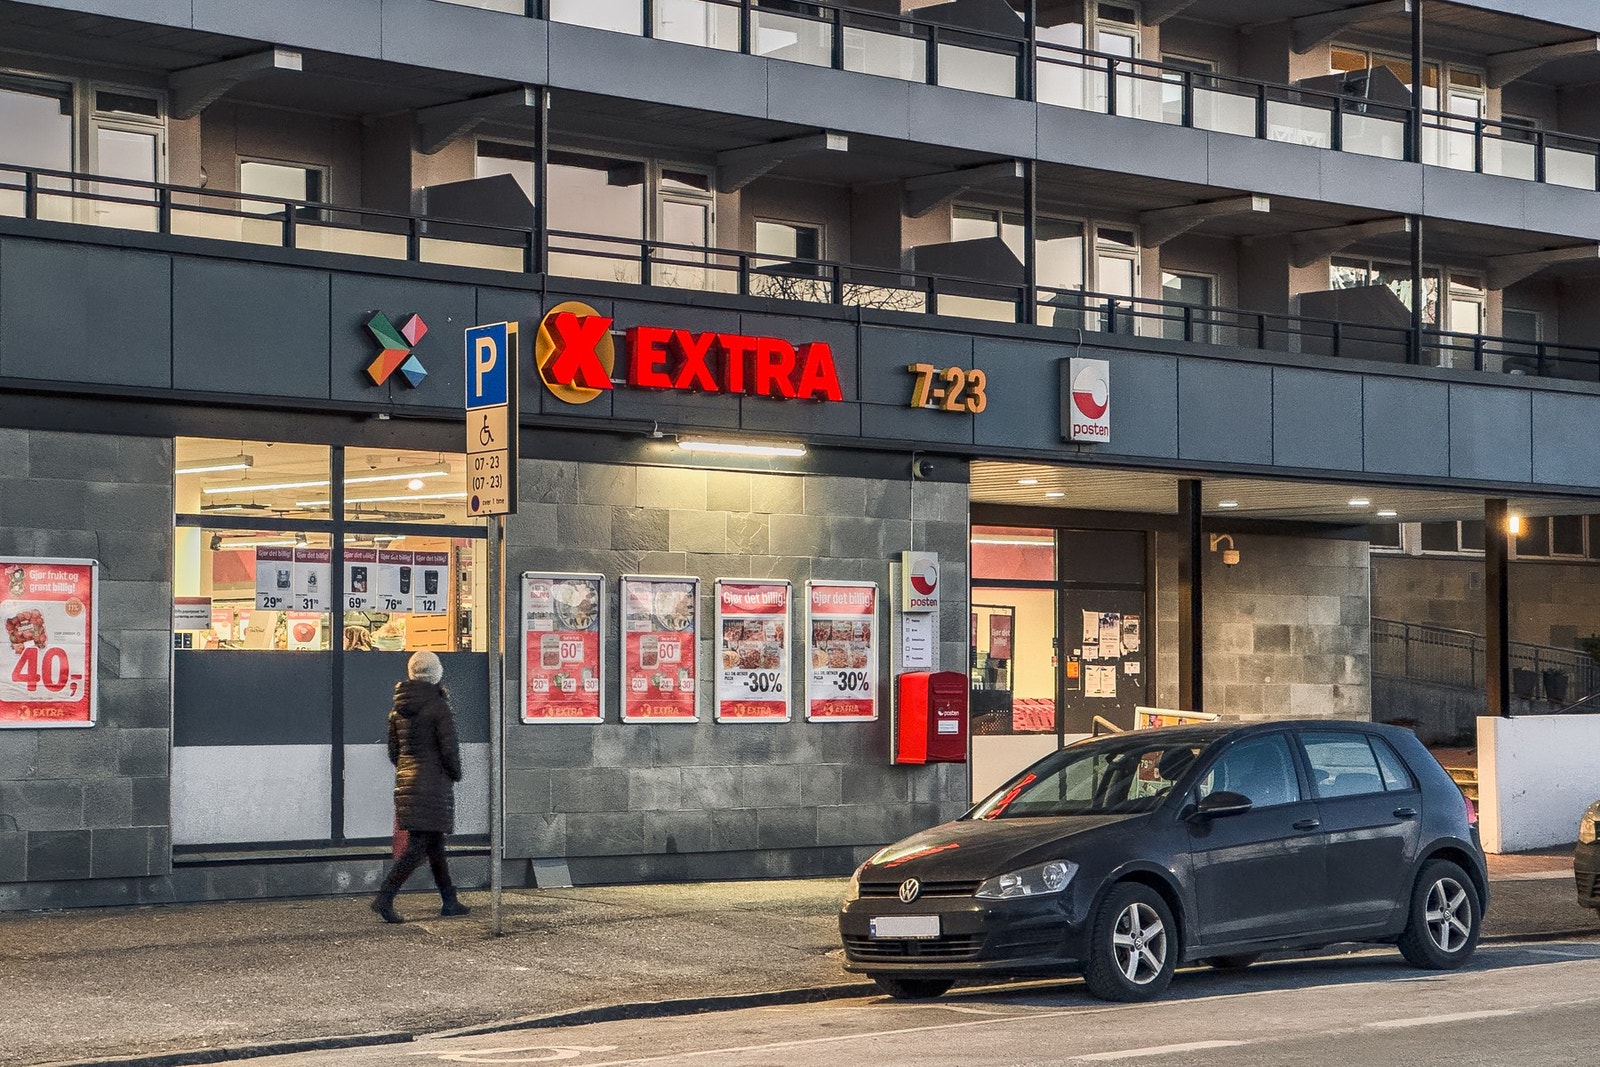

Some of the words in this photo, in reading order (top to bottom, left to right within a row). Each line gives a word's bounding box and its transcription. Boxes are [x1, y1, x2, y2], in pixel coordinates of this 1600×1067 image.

[476, 336, 498, 397] P
[626, 326, 842, 402] EXTRA
[908, 363, 988, 414] 7-23
[1073, 422, 1109, 437] posten
[30, 570, 46, 580] Gjør
[47, 570, 68, 580] frukt
[69, 572, 79, 581] og
[29, 583, 51, 593] grønt
[52, 582, 76, 593] billig!
[723, 591, 743, 606] Gjør
[744, 592, 760, 604] det
[762, 592, 786, 607] billig!
[812, 592, 831, 606] Gjør
[832, 592, 847, 604] det
[910, 597, 938, 608] posten
[423, 600, 436, 611] 121
[743, 672, 782, 692] -30%
[833, 671, 869, 691] -30%
[32, 708, 65, 717] EXTRA
[555, 707, 583, 716] EXTRA
[654, 706, 679, 715] EXTRA
[747, 706, 771, 715] EXTRA
[944, 709, 959, 717] posten
